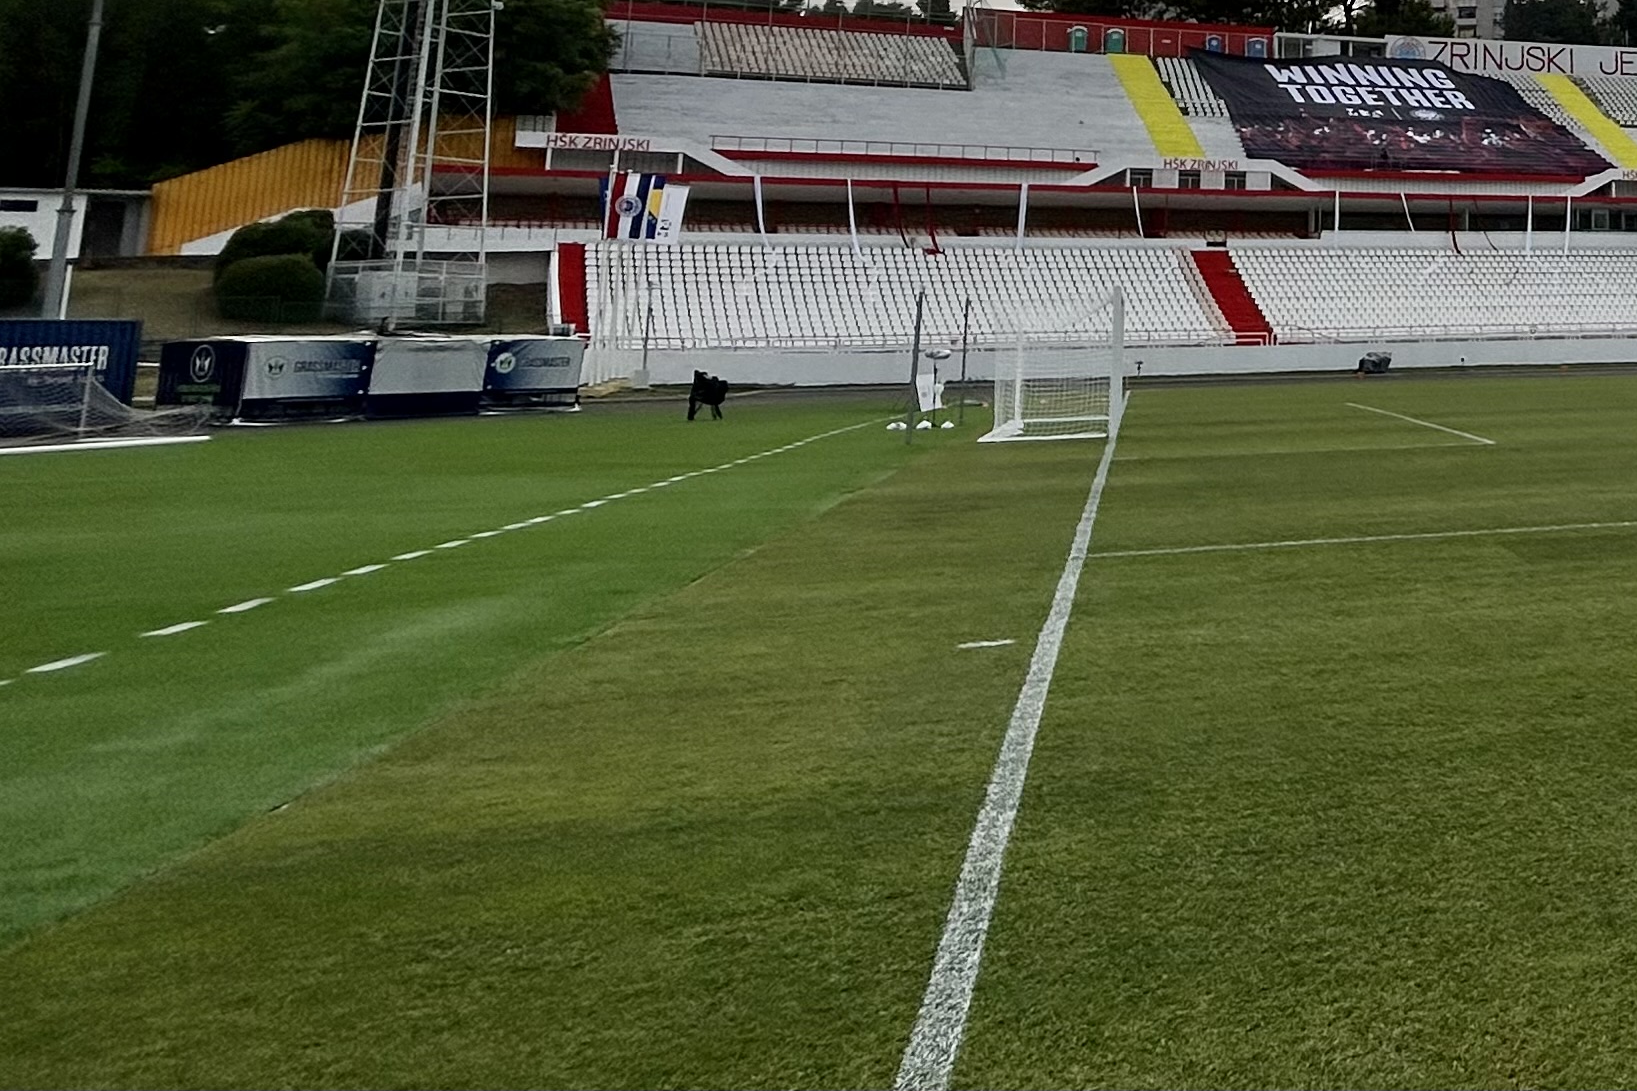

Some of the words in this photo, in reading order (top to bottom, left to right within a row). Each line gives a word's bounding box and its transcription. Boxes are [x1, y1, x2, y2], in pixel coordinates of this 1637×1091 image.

[1428, 41, 1575, 74] ZRINJSKI
[1264, 63, 1456, 89] WINNING
[1277, 84, 1476, 110] TOGETHER
[546, 134, 578, 148] HŠK
[582, 136, 650, 152] ZRINJSKI
[1163, 158, 1187, 169] HŠK
[1190, 159, 1239, 171] ZRINJSKI
